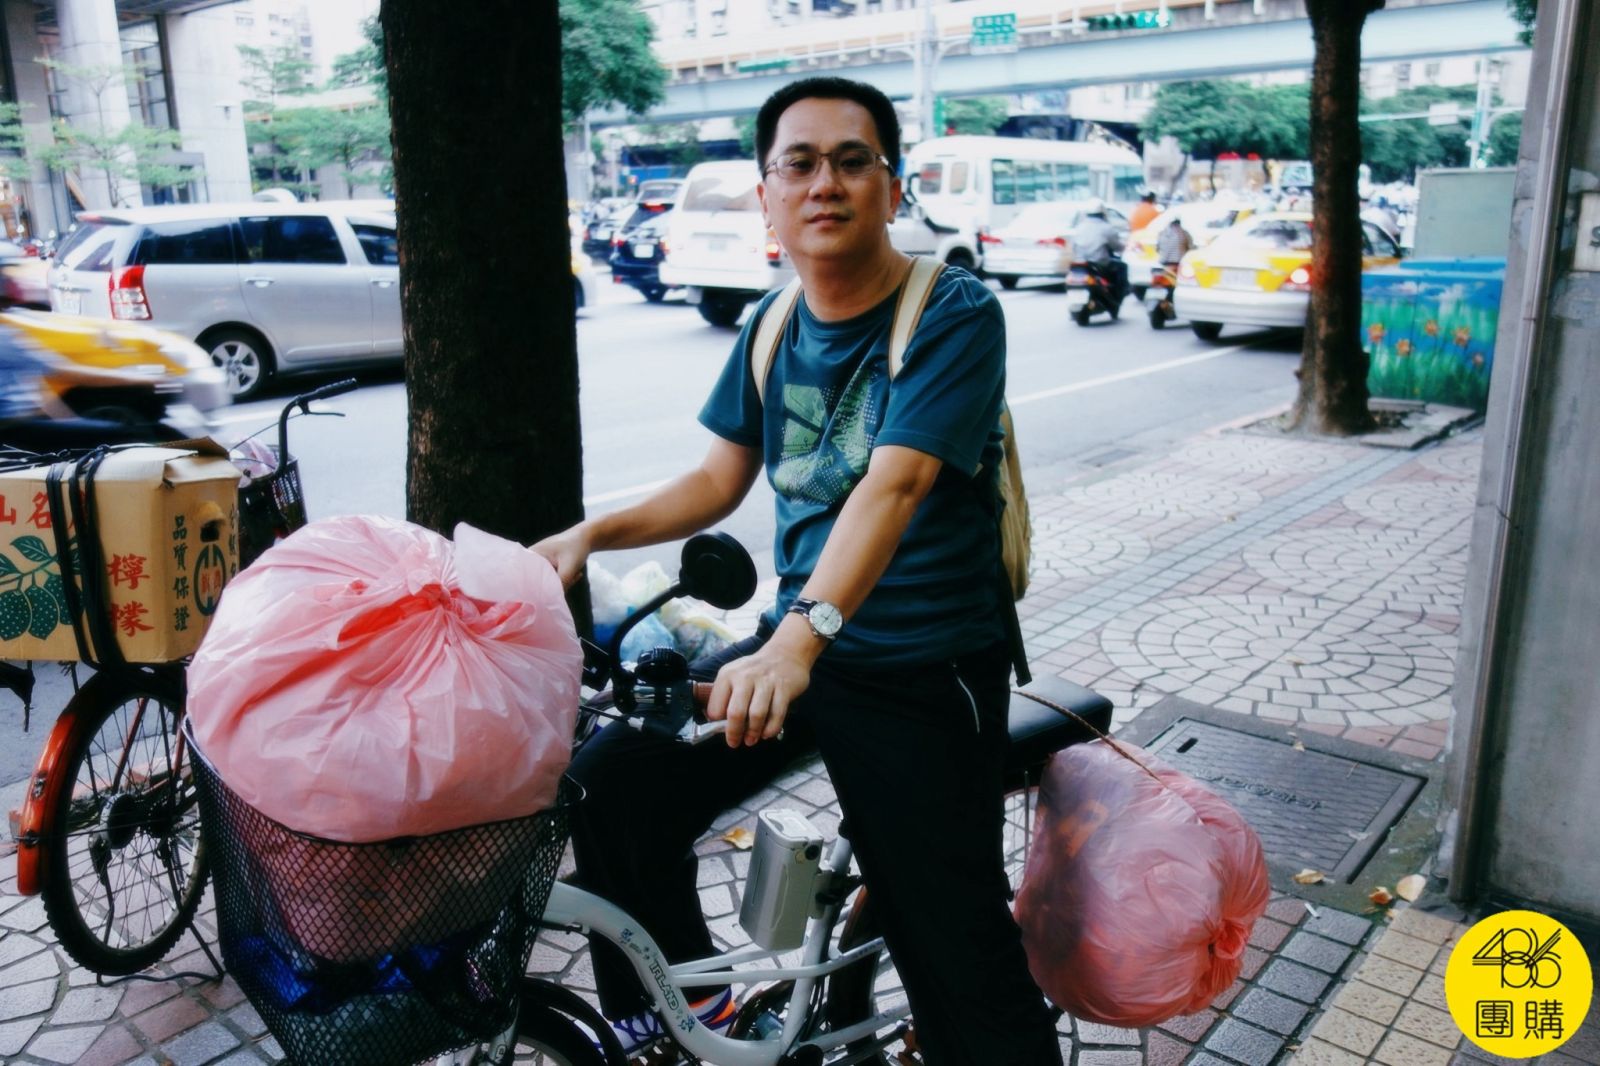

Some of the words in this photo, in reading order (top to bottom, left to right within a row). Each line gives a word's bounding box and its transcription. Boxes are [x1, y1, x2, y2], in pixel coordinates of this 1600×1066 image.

[107, 553, 155, 637] 檸檬
[173, 515, 189, 631] 品質保證
